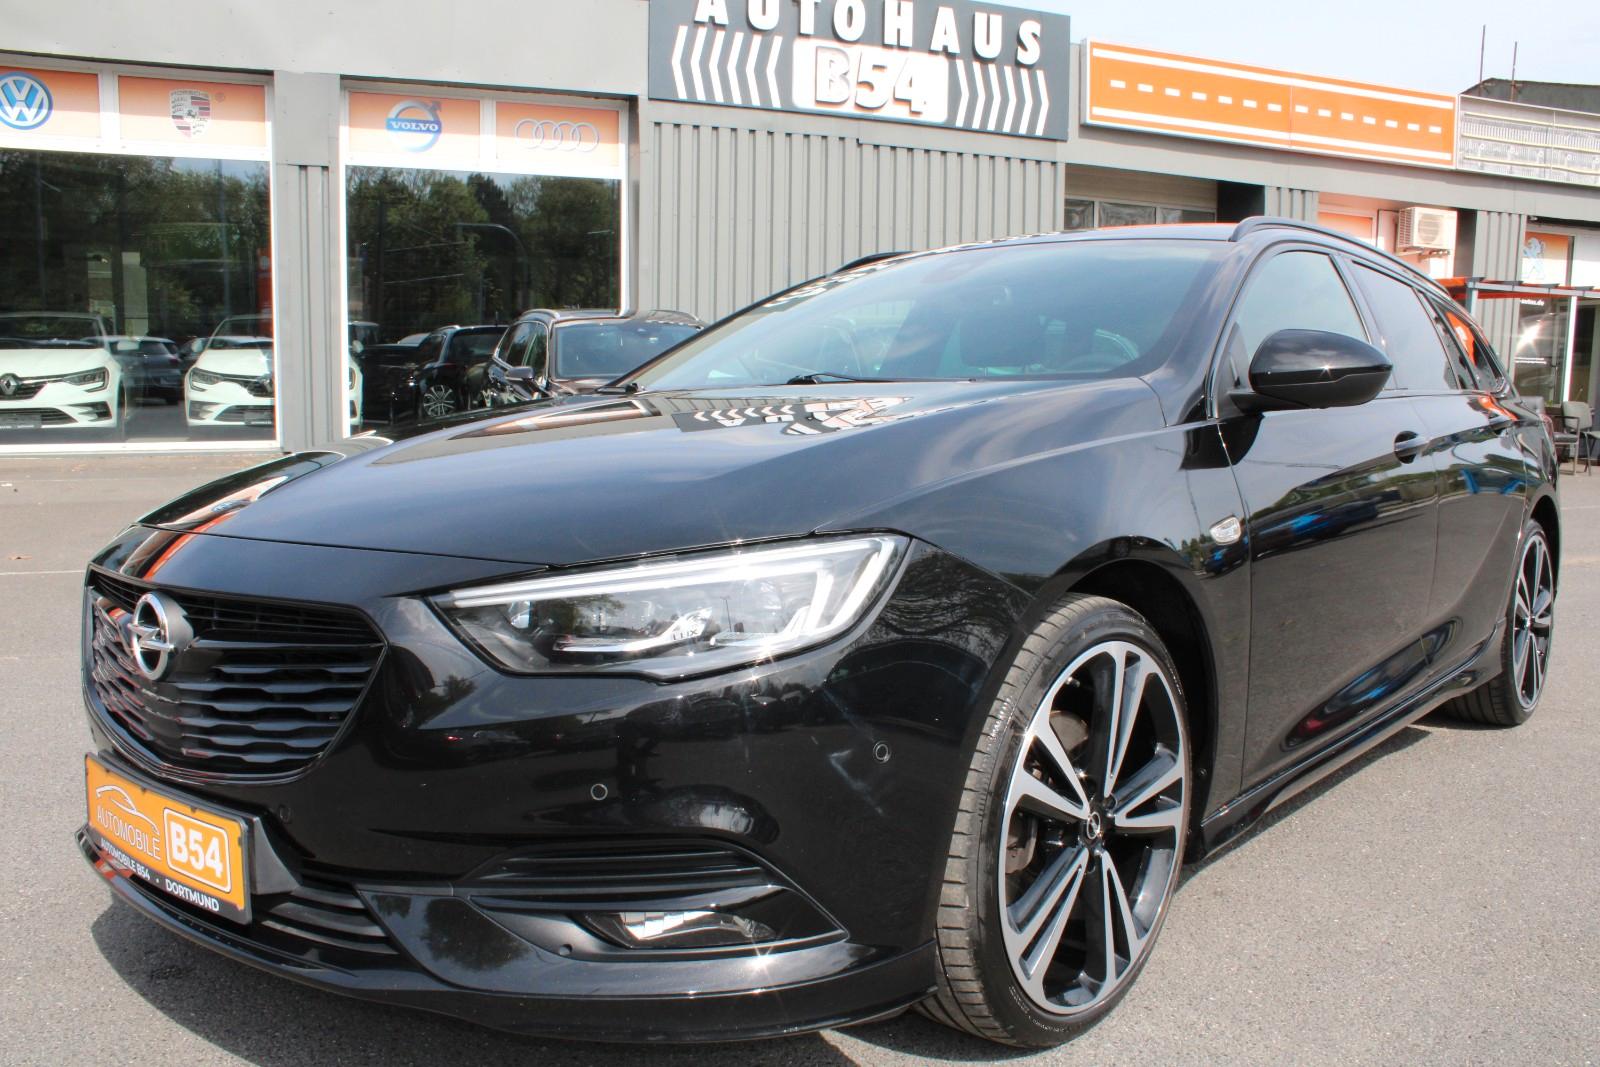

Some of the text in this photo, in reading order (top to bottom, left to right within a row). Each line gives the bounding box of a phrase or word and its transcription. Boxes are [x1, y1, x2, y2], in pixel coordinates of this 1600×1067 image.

[694, 0, 1042, 66] AUTOHAUS
[814, 45, 929, 115] B54
[391, 121, 439, 132] VOLVO
[97, 805, 224, 879] AUTOMOBILE B54
[101, 838, 220, 912] AUTOMOBILE B54 DORTMUND
